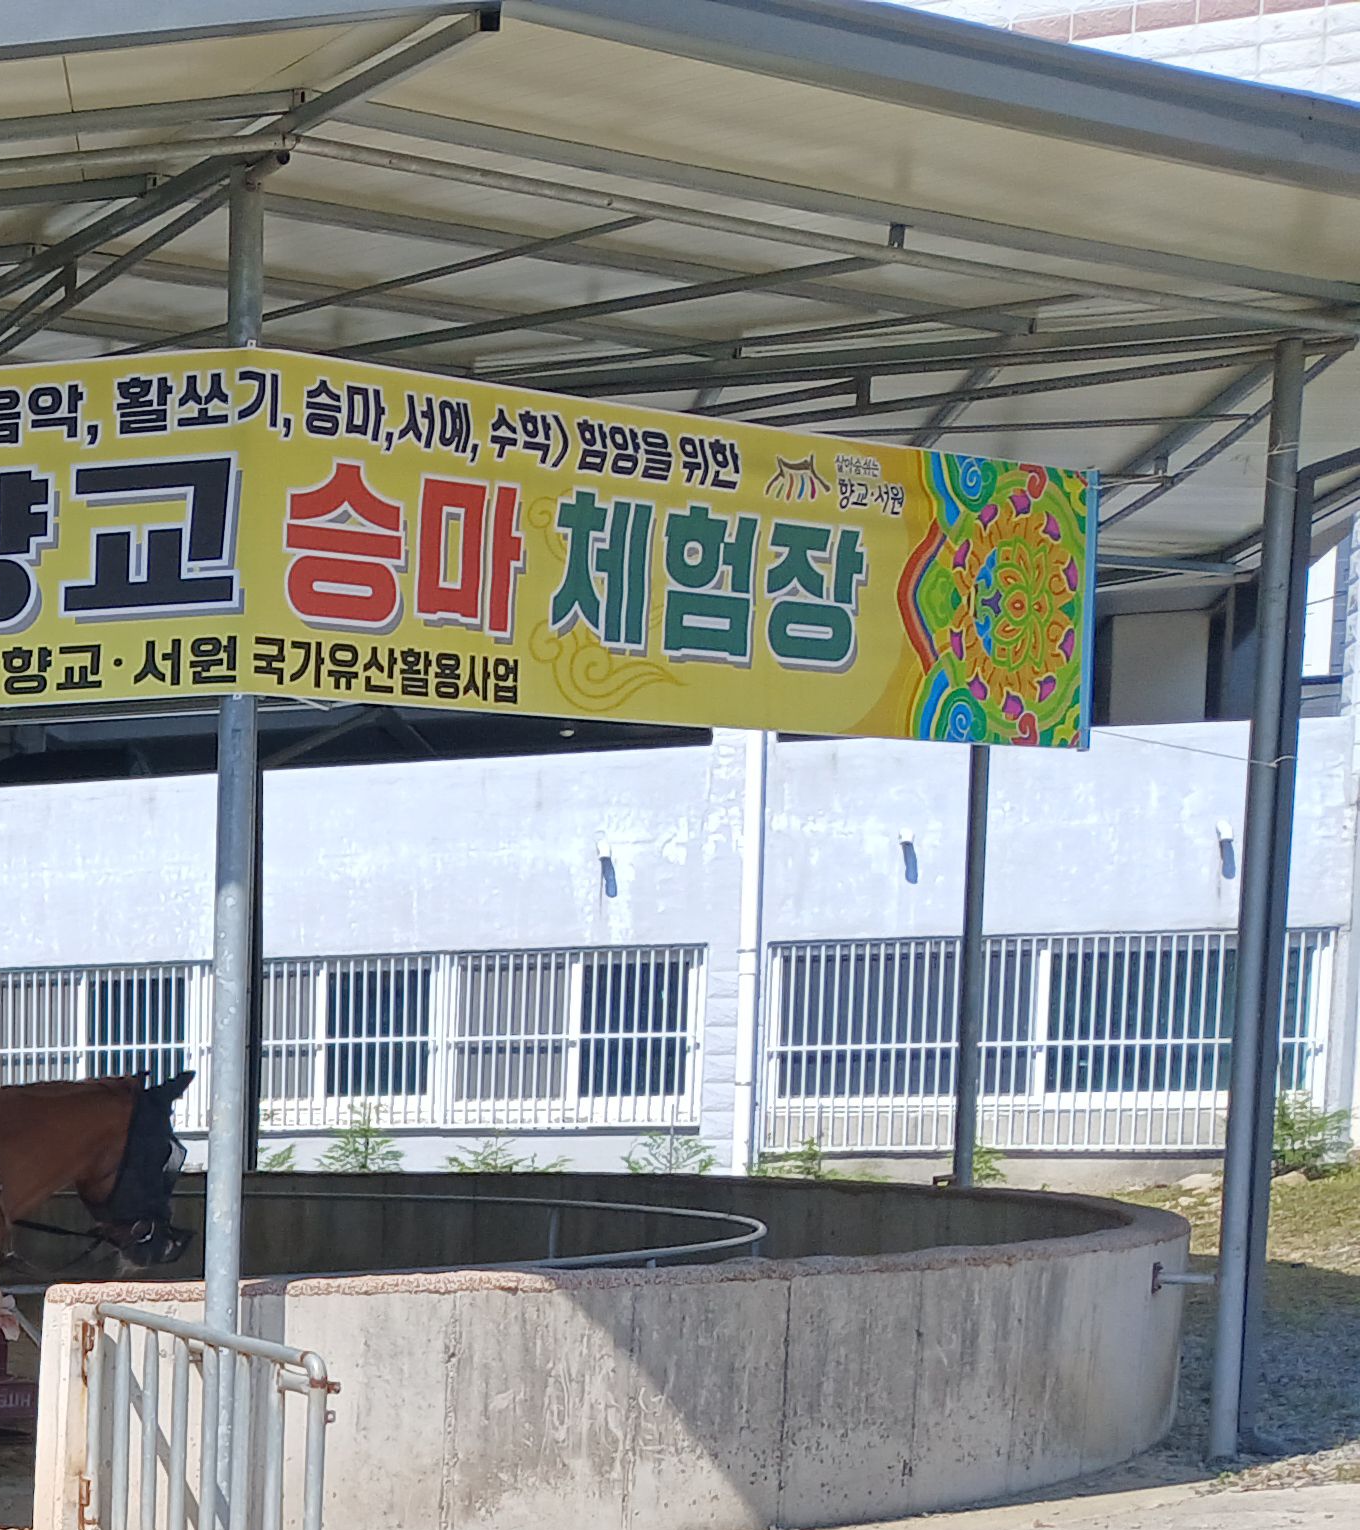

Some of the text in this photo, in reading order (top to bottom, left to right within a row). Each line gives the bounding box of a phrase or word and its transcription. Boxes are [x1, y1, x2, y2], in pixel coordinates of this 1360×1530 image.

[116, 369, 291, 438] 활쏘기,
[491, 408, 569, 468] 수학)
[577, 419, 672, 481] 함양을
[680, 436, 740, 490] 위한
[286, 462, 523, 634] 승마
[551, 489, 864, 664] 체험장
[253, 636, 519, 704] 국가유산활용사업
[0, 1392, 30, 1409] HITE
